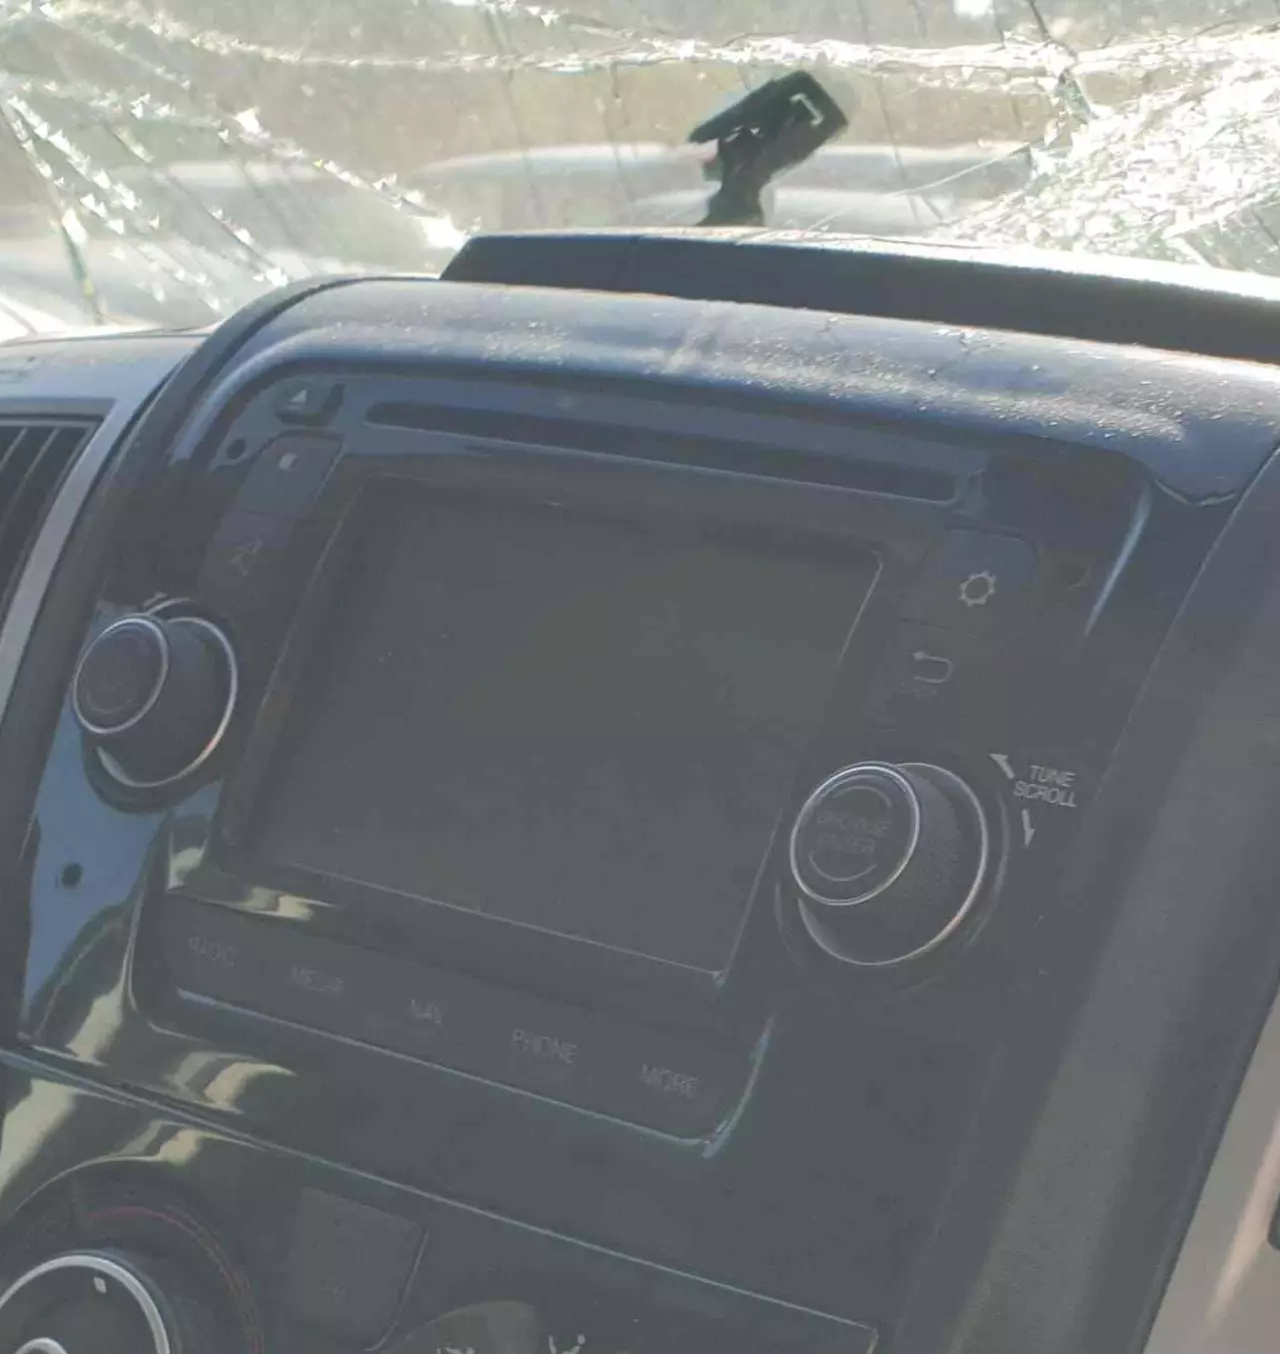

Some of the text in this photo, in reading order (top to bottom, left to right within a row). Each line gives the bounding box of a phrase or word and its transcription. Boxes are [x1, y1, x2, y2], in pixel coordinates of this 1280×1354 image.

[1028, 763, 1077, 788] TUNE
[1012, 779, 1078, 809] SCROLL
[512, 1028, 578, 1065] PHONE
[639, 1062, 700, 1099] MORE
